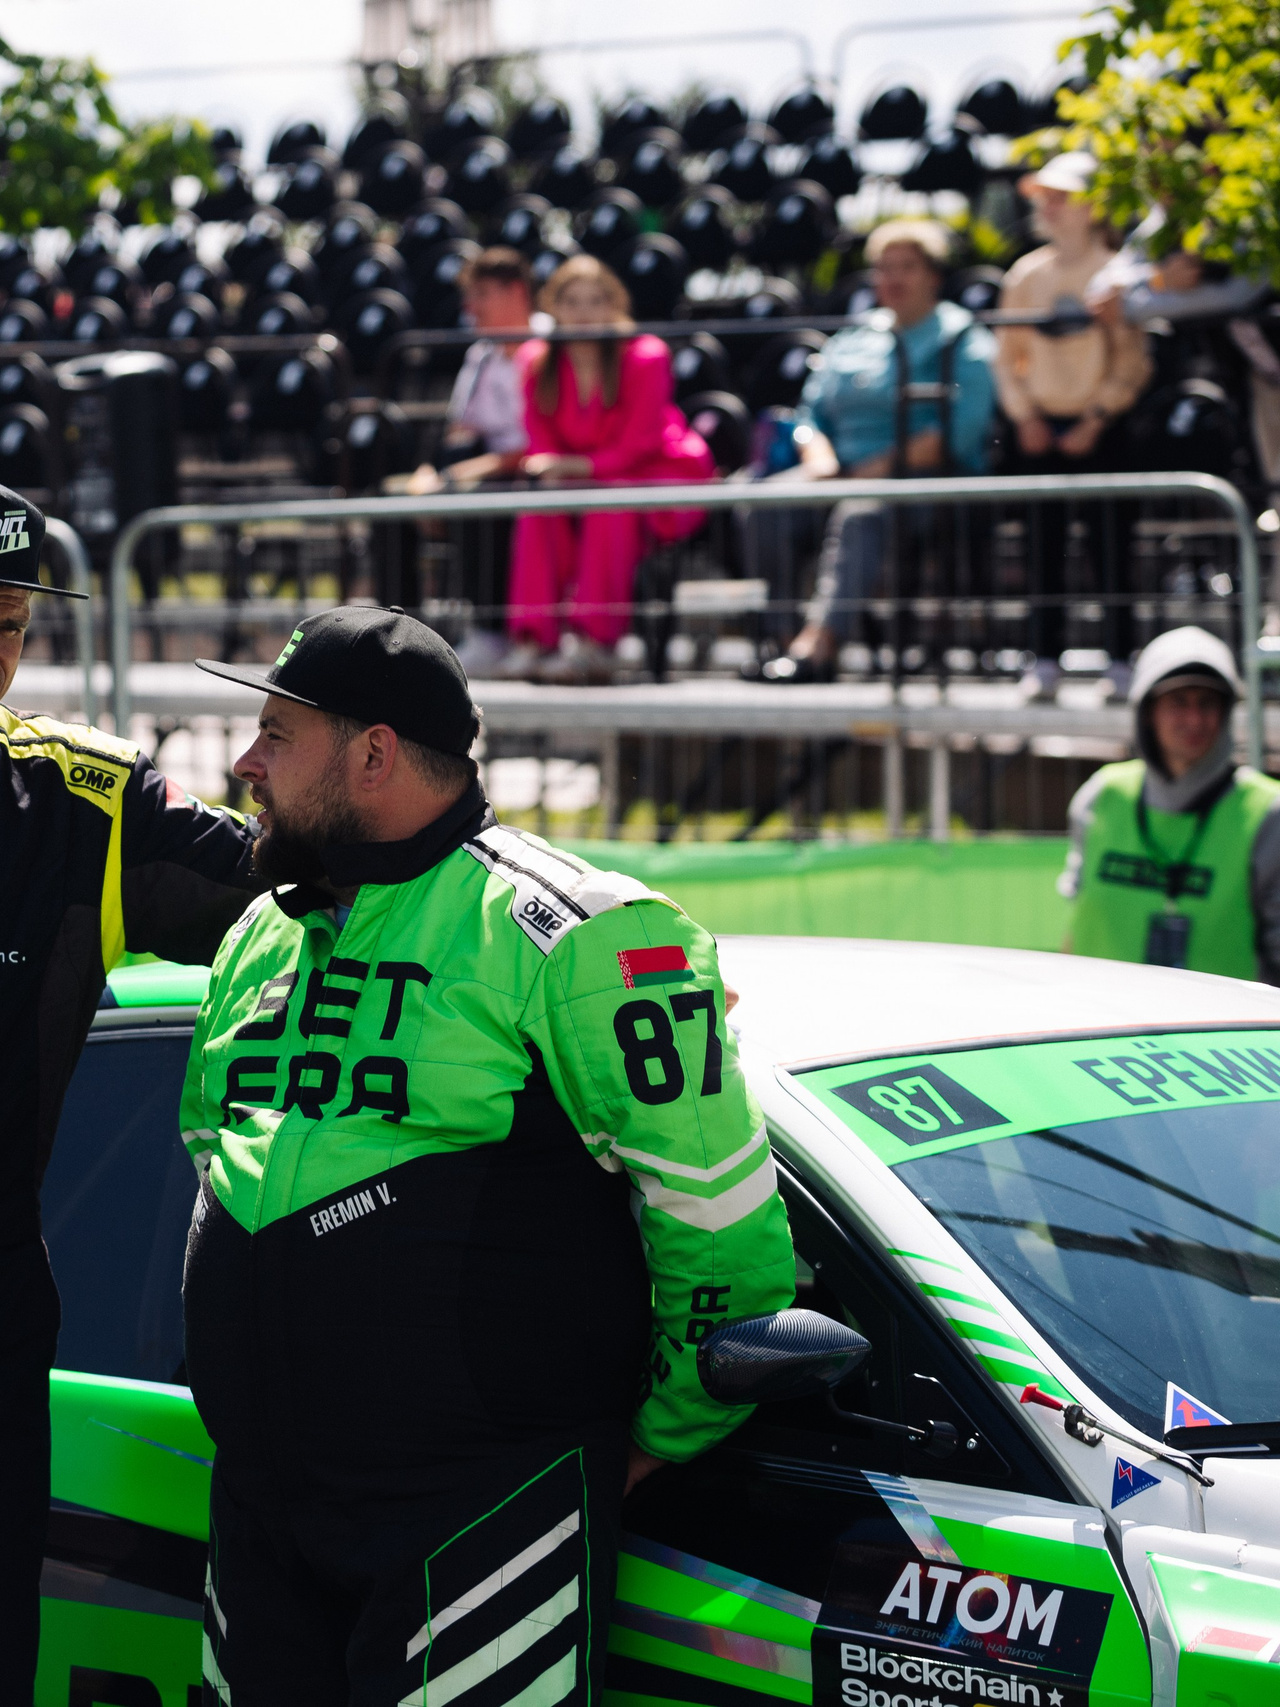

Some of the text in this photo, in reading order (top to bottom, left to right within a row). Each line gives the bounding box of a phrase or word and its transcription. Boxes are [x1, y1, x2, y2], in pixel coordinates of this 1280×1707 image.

[70, 766, 115, 792] OMP
[524, 901, 563, 931] OMP
[613, 989, 723, 1106] 87
[1072, 1041, 1280, 1106] ЕРЁМИ
[867, 1075, 965, 1132] 87
[309, 1182, 397, 1237] EREMIN V.
[879, 1561, 1064, 1647] ATOM
[874, 1619, 1047, 1662] ЭНЕРГЕТИЧЕСКИЙ НАПИТОК
[840, 1642, 1040, 1706] Blockchain
